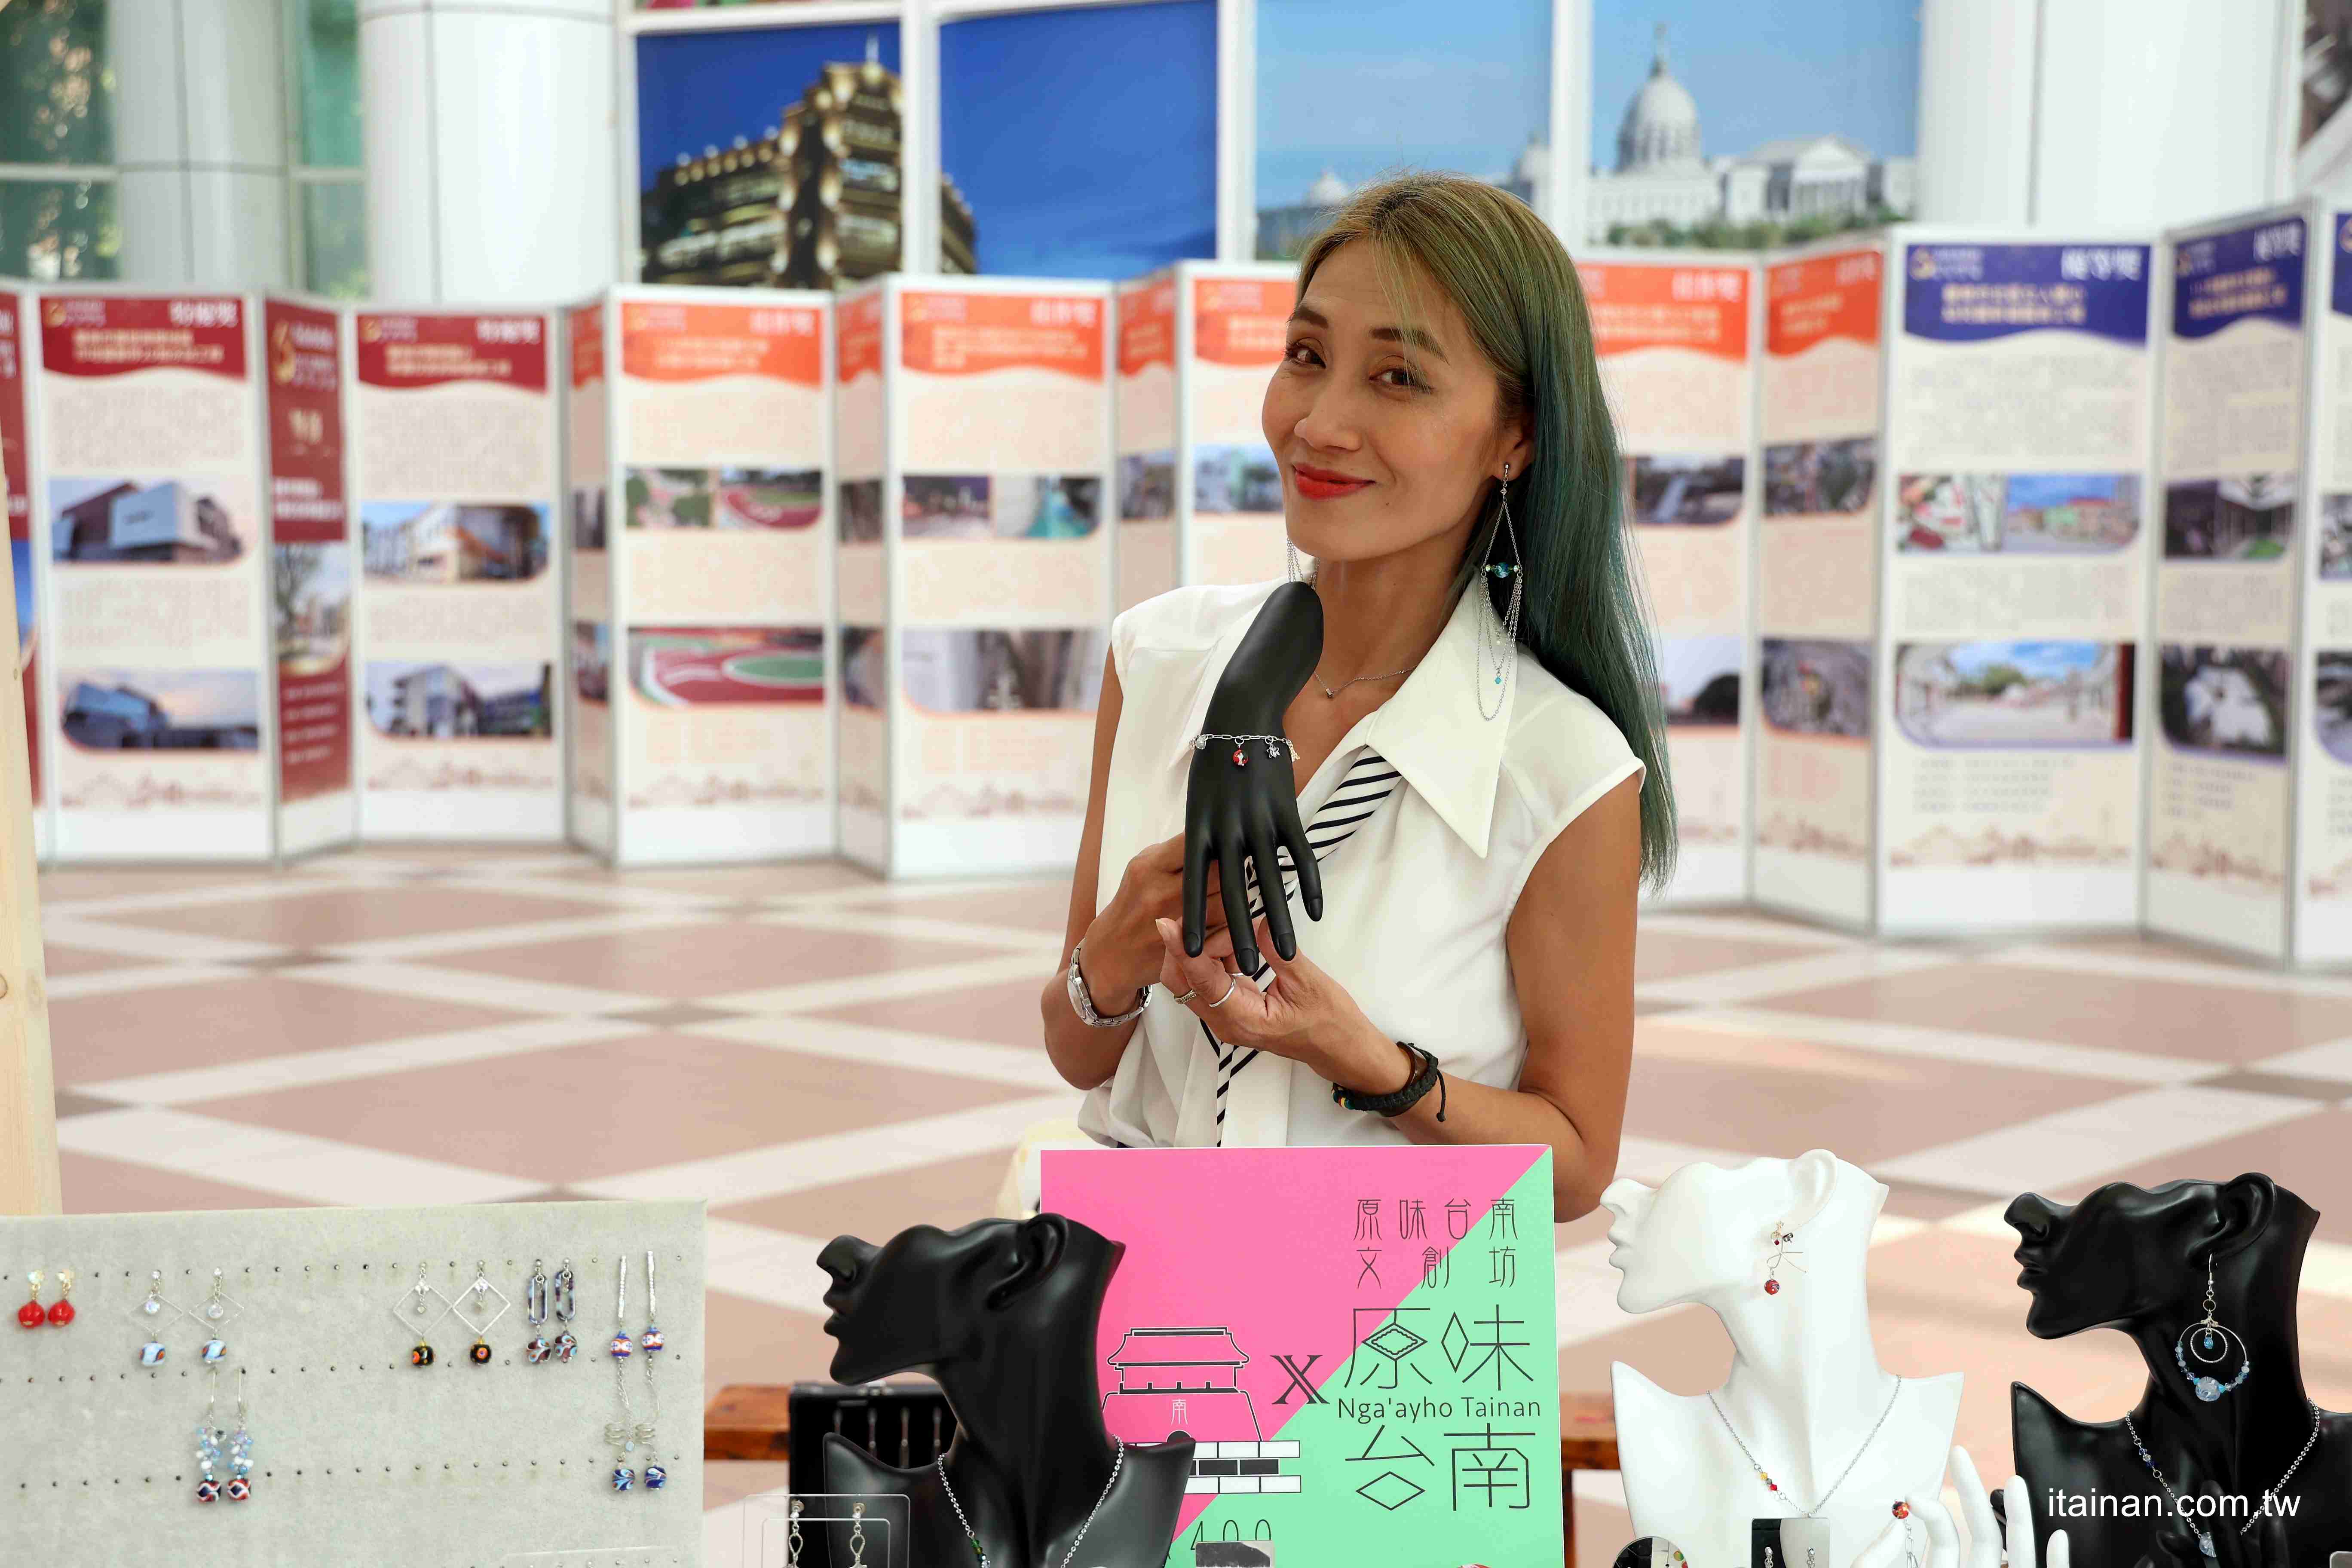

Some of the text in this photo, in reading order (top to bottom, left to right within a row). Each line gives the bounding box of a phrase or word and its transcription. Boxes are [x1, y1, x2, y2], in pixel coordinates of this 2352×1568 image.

[1354, 1198, 1517, 1240] 原味台南
[1356, 1246, 1516, 1289] 文創坊
[1344, 1304, 1534, 1391] 原味
[1171, 1398, 1188, 1425] 南
[1338, 1396, 1541, 1424] Nga'ayho Tainan
[1345, 1422, 1536, 1511] 台南
